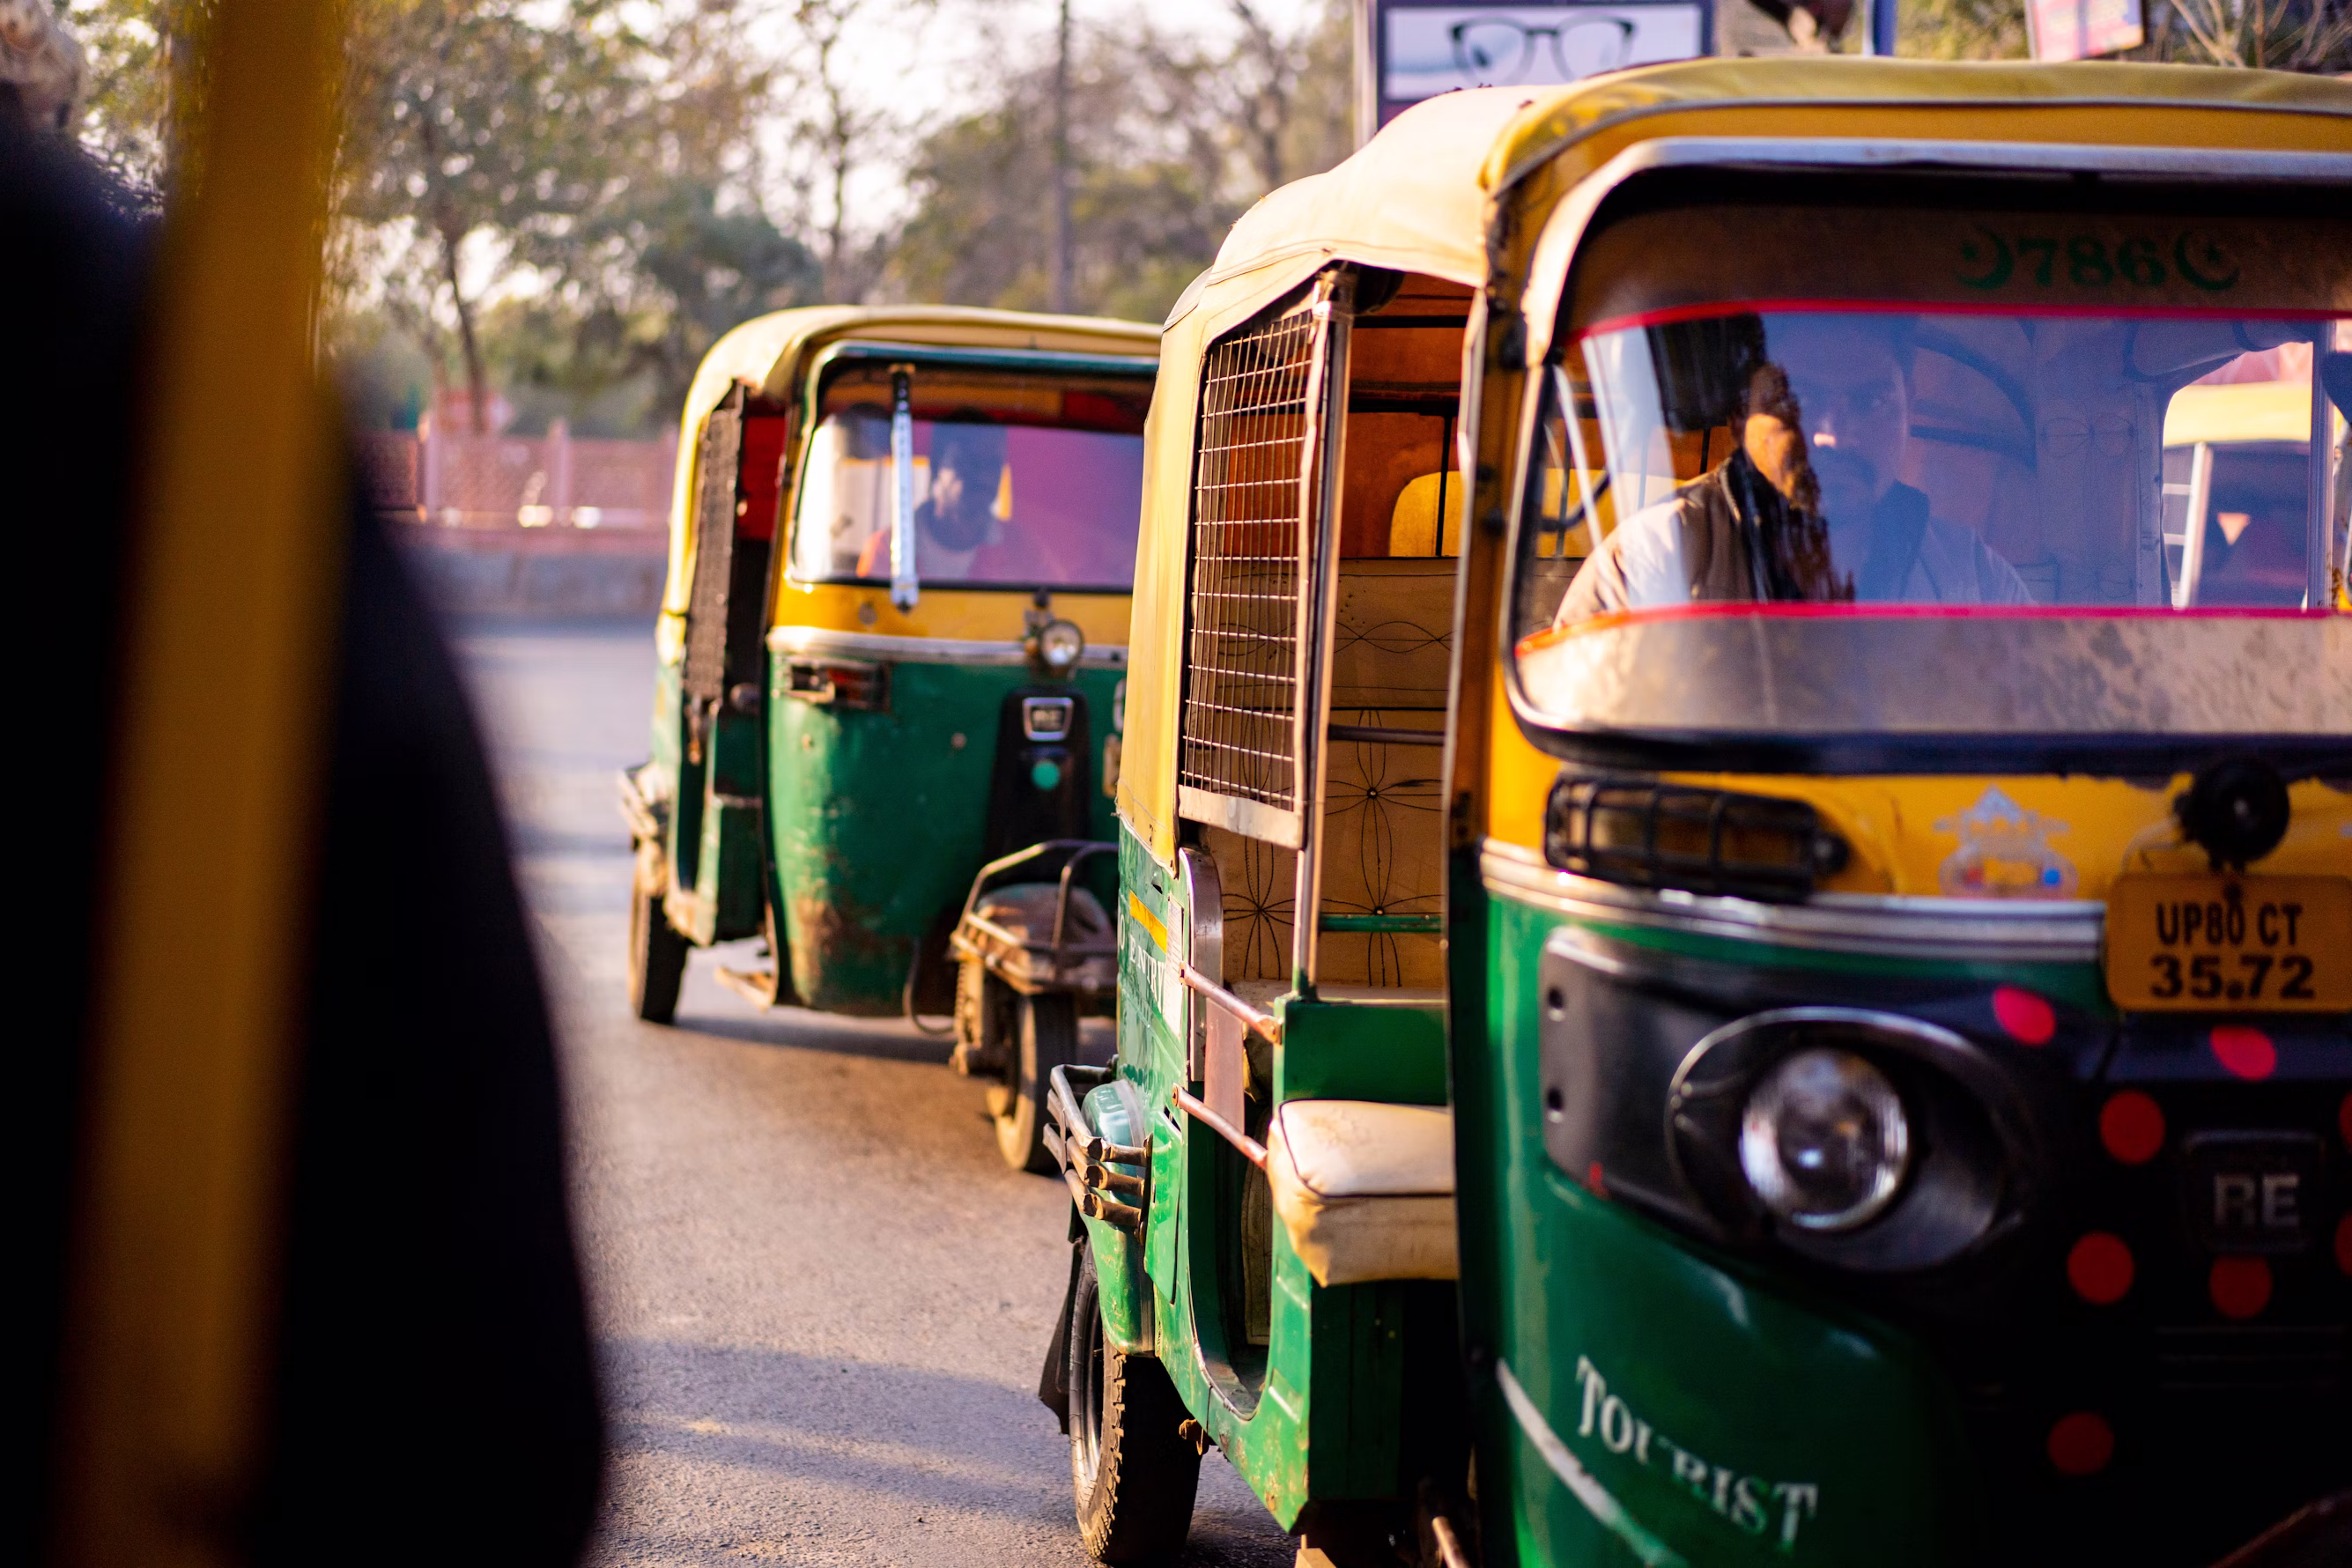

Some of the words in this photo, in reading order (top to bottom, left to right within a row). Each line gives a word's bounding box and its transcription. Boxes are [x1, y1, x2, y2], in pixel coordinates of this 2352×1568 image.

[2016, 235, 2166, 287] 786
[2156, 901, 2245, 946] UP80
[2256, 901, 2304, 946] CT
[2149, 954, 2316, 1000] 35.72
[2215, 1173, 2299, 1226] RE
